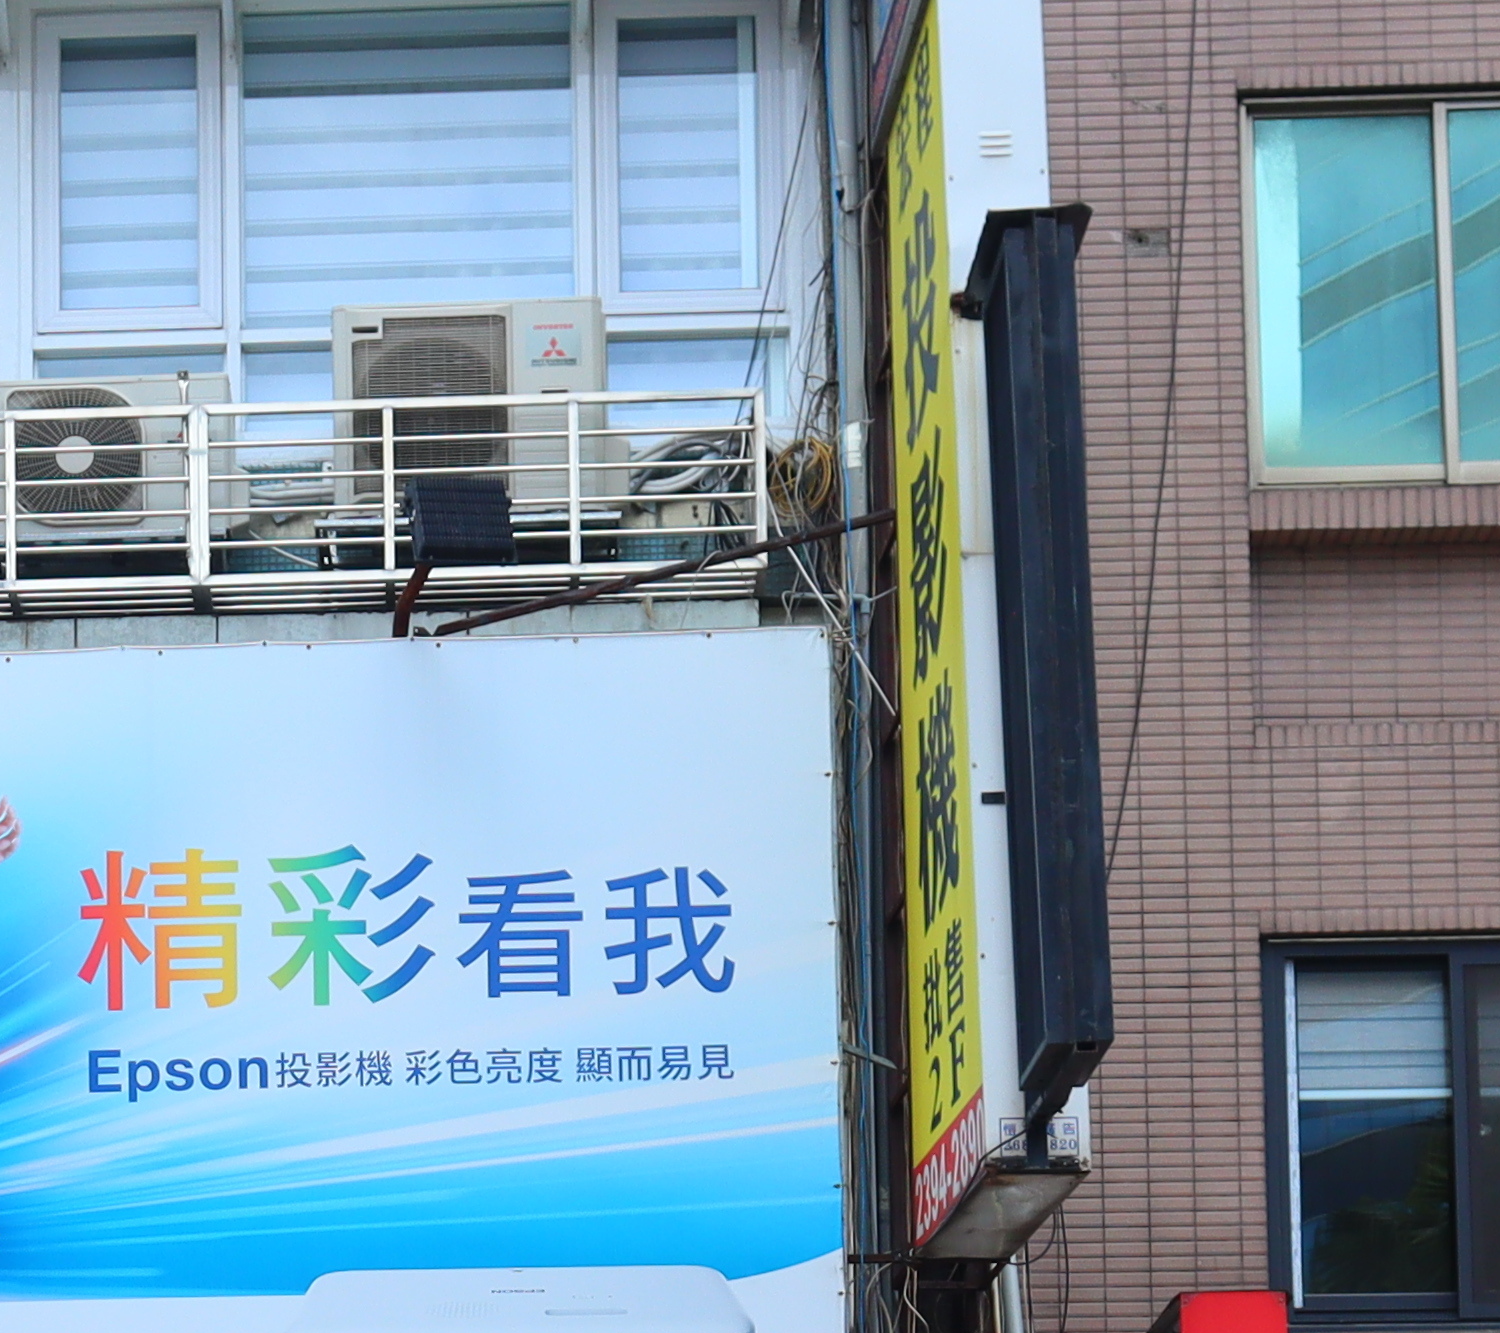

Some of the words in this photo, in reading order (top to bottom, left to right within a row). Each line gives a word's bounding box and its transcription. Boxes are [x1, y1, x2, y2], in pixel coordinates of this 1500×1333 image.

[76, 845, 736, 1011] 精彩看我
[923, 917, 965, 1052] 批售
[88, 1049, 393, 1102] Epson投影機
[405, 1047, 564, 1086] 彩色亮度
[575, 1043, 735, 1084] 顯而易見
[928, 1017, 966, 1134] 2F
[914, 1097, 985, 1241] 2394-2890
